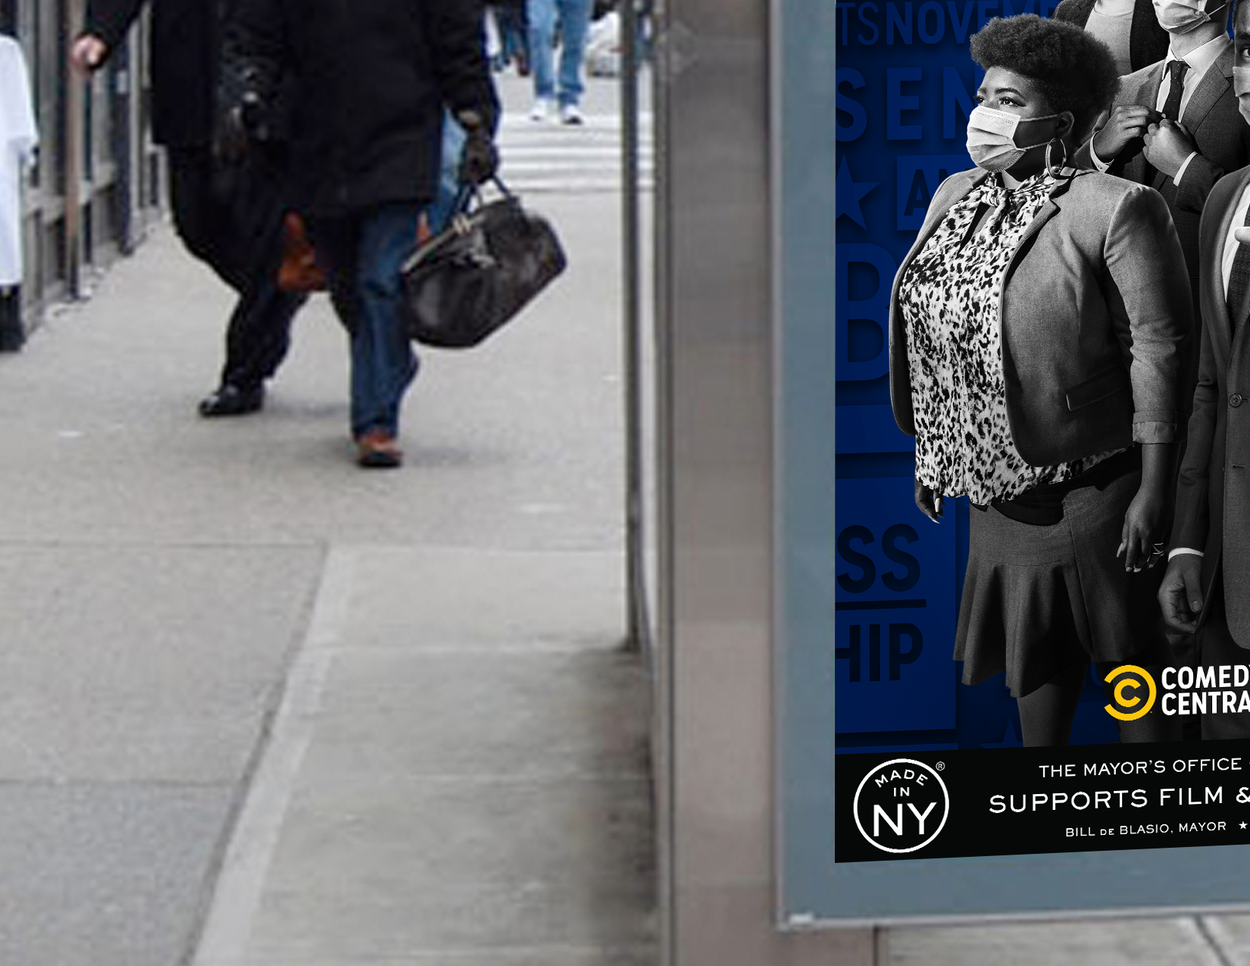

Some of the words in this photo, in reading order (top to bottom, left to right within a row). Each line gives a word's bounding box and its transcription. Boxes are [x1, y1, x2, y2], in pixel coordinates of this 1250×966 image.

[1039, 764, 1075, 777] THE
[1173, 758, 1241, 772] OFFICE
[875, 769, 928, 788] MADE
[894, 787, 909, 797] IN
[989, 789, 1147, 813] SUPPORTS
[1160, 786, 1222, 806] FILM
[873, 802, 937, 837] NY
[1066, 827, 1095, 837] BILL
[1120, 824, 1173, 834] BLASIO,
[1179, 822, 1226, 832] MAYOR
